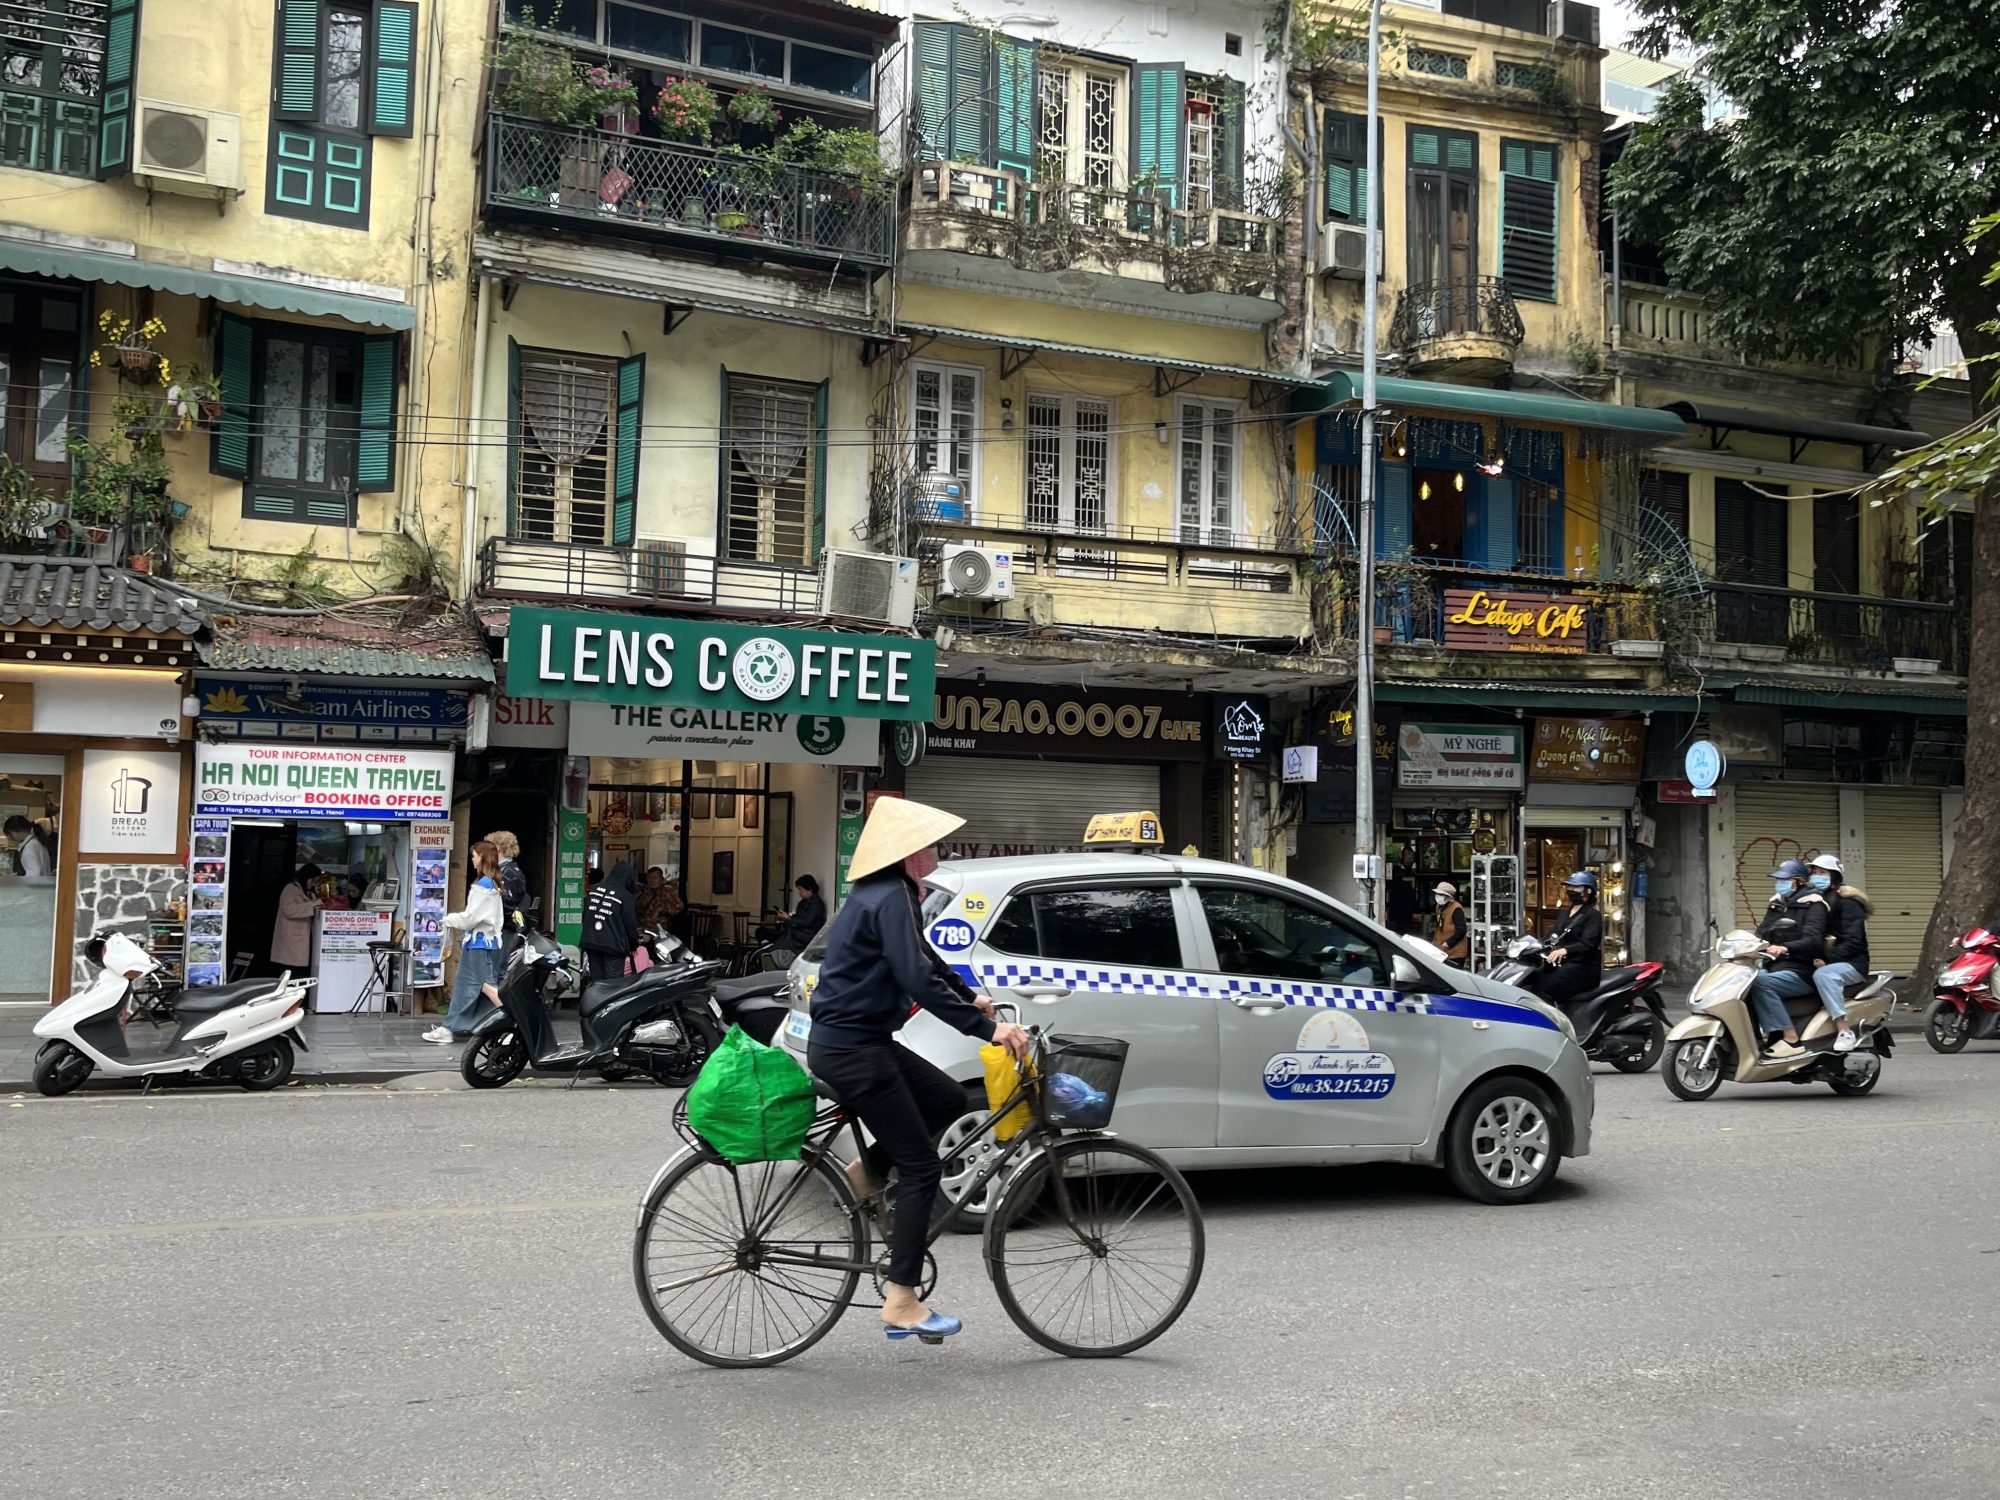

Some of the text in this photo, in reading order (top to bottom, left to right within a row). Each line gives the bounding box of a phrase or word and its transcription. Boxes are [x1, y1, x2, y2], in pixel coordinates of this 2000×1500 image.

[1536, 604, 1586, 638] Café
[539, 624, 675, 688] LENS
[743, 643, 786, 659] LENS
[766, 672, 788, 694] COFFEE
[351, 698, 431, 719] Airlines
[495, 694, 554, 725] Silk
[610, 704, 789, 733] THE GALLERY
[812, 716, 831, 743] 5
[647, 734, 682, 745] passion
[953, 738, 976, 749] KHAY
[249, 749, 406, 764] TOUR INFORMATION CENTER
[202, 762, 445, 791] HA NOI QUEEN TRAVEL
[233, 791, 442, 807] tripadvisor BOOKING OFFICE
[112, 817, 147, 826] BREAD
[195, 819, 228, 828] SAPA TOUR
[414, 825, 451, 835] EXCHANGE
[419, 836, 445, 846] MONEY
[965, 898, 985, 910] be
[934, 925, 971, 946] 789
